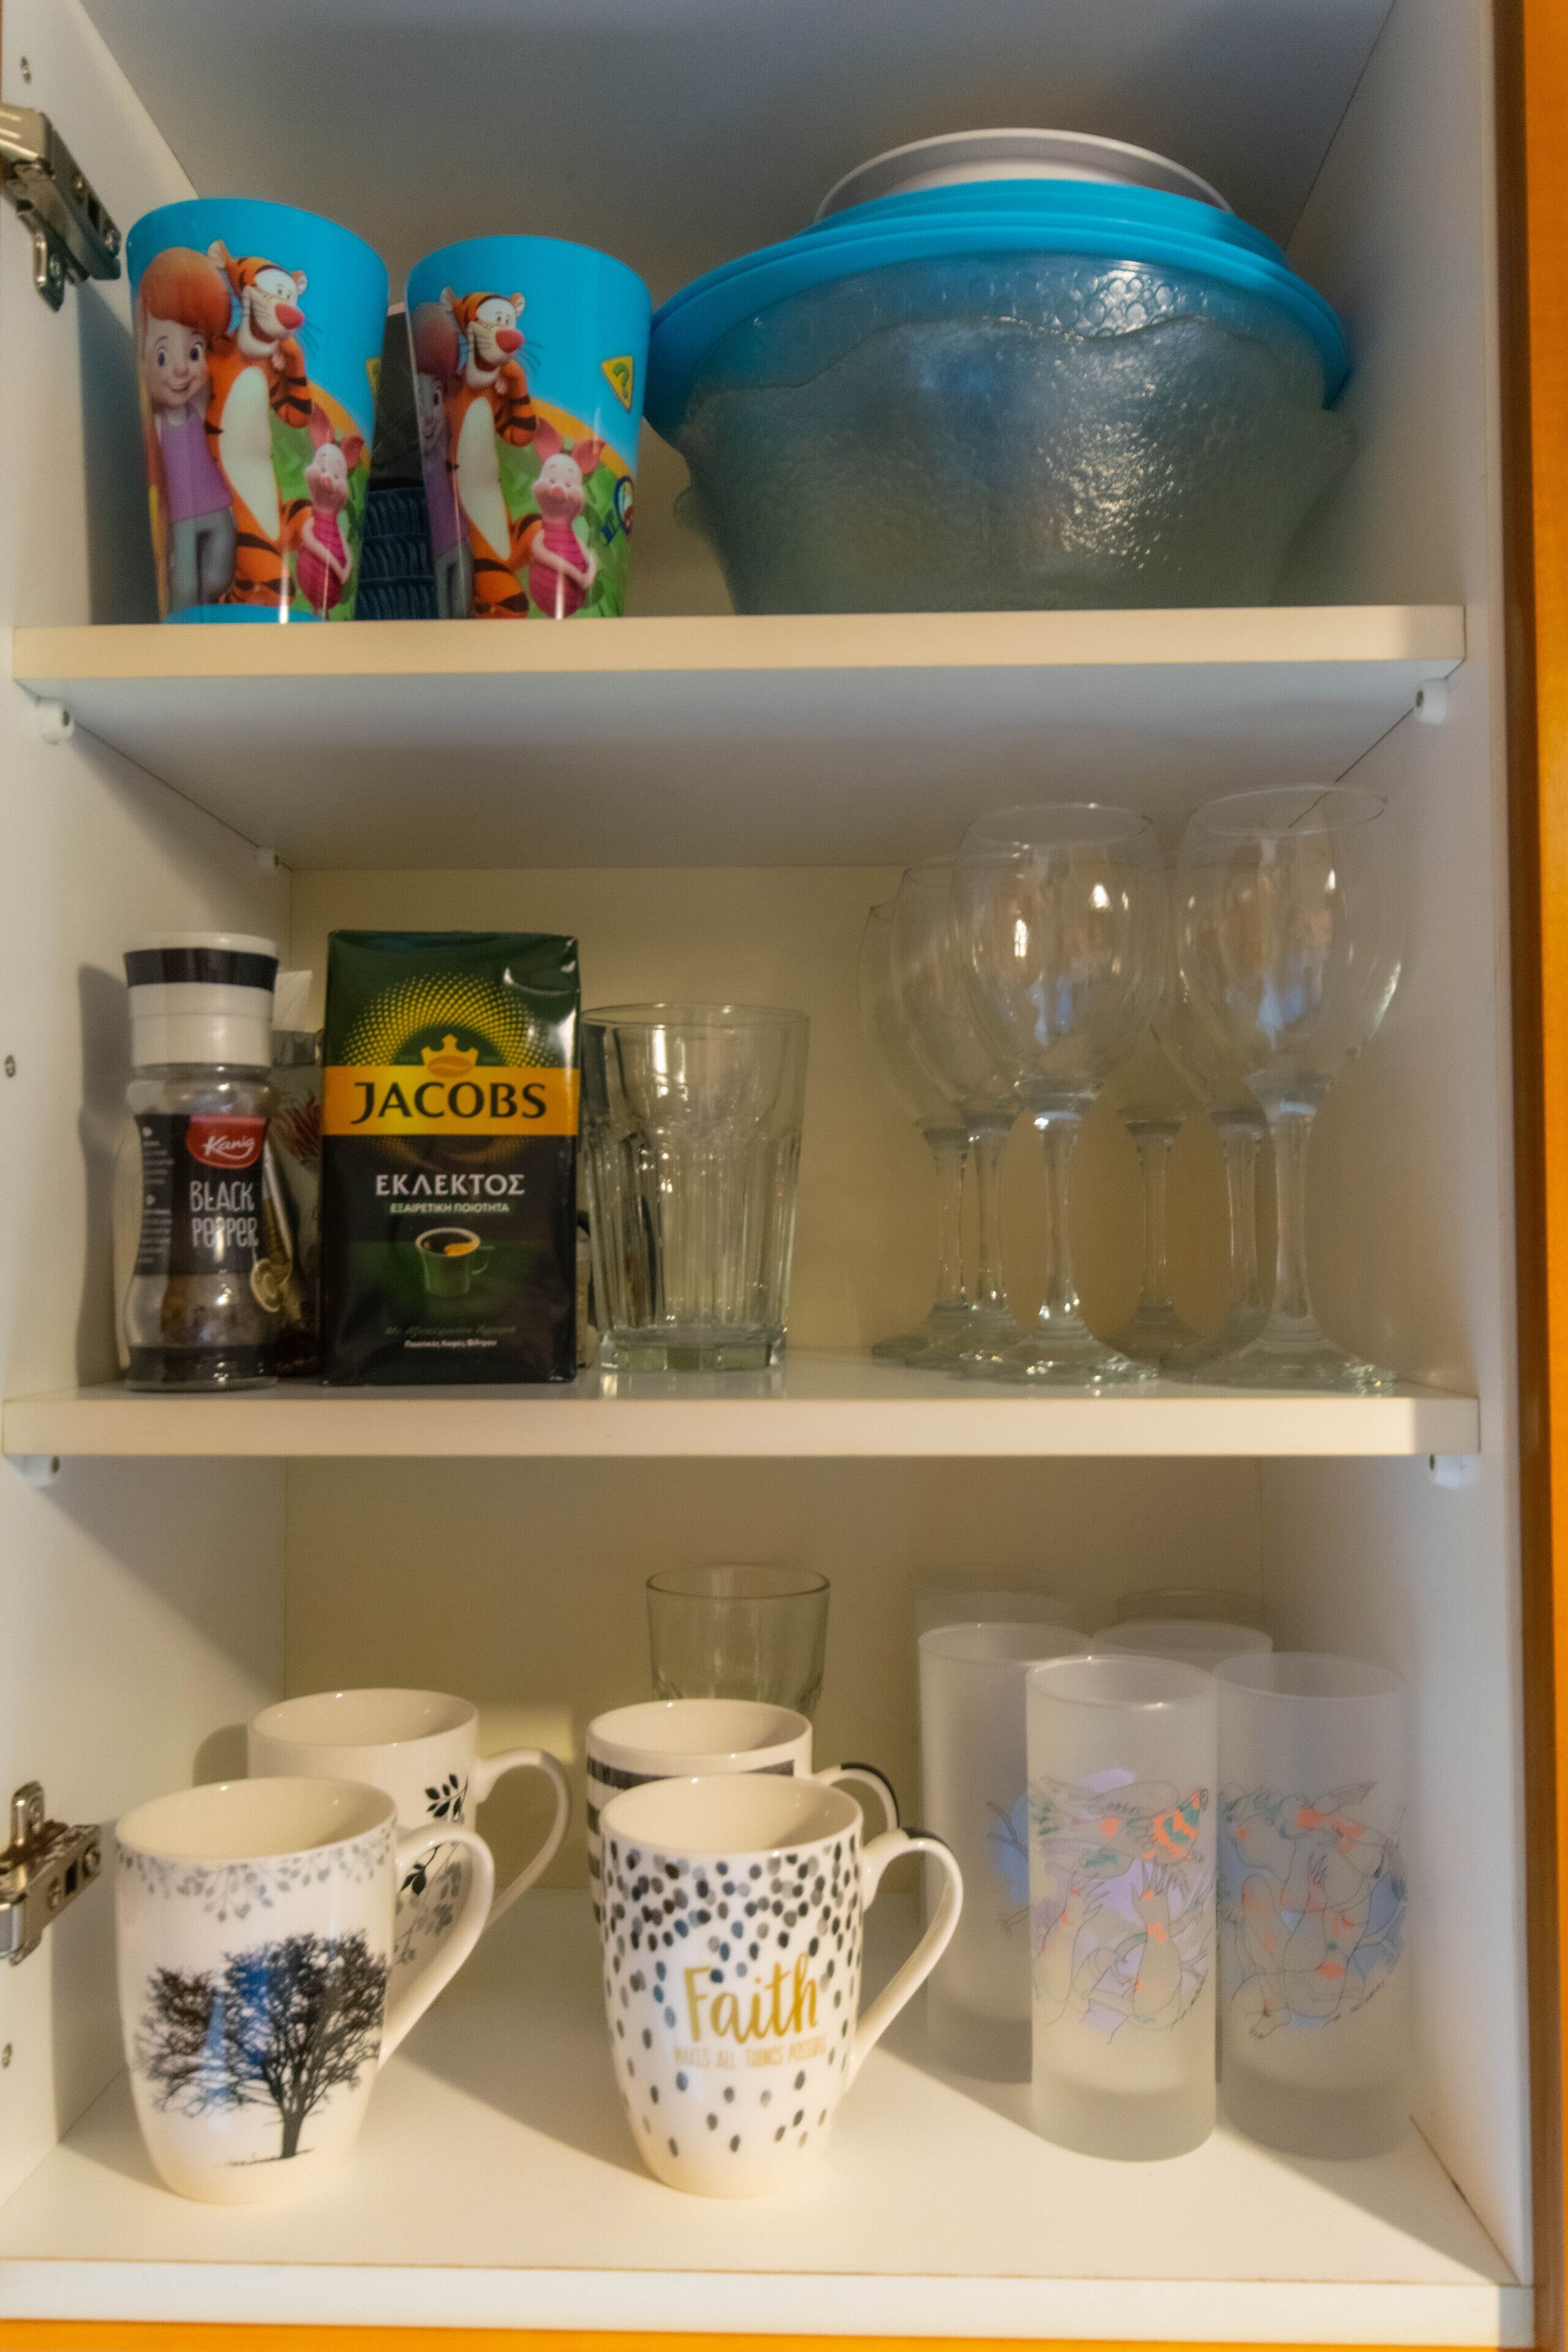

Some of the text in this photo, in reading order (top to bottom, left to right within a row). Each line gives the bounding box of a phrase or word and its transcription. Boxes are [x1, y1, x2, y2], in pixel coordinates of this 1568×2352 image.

[350, 1081, 547, 1125] JACOBS
[189, 1180, 255, 1212] BLACK
[375, 1174, 526, 1196] ΕΚΛΕΚΤΟΣ
[191, 1216, 258, 1248] PEPPER
[684, 1951, 817, 2043] Faith
